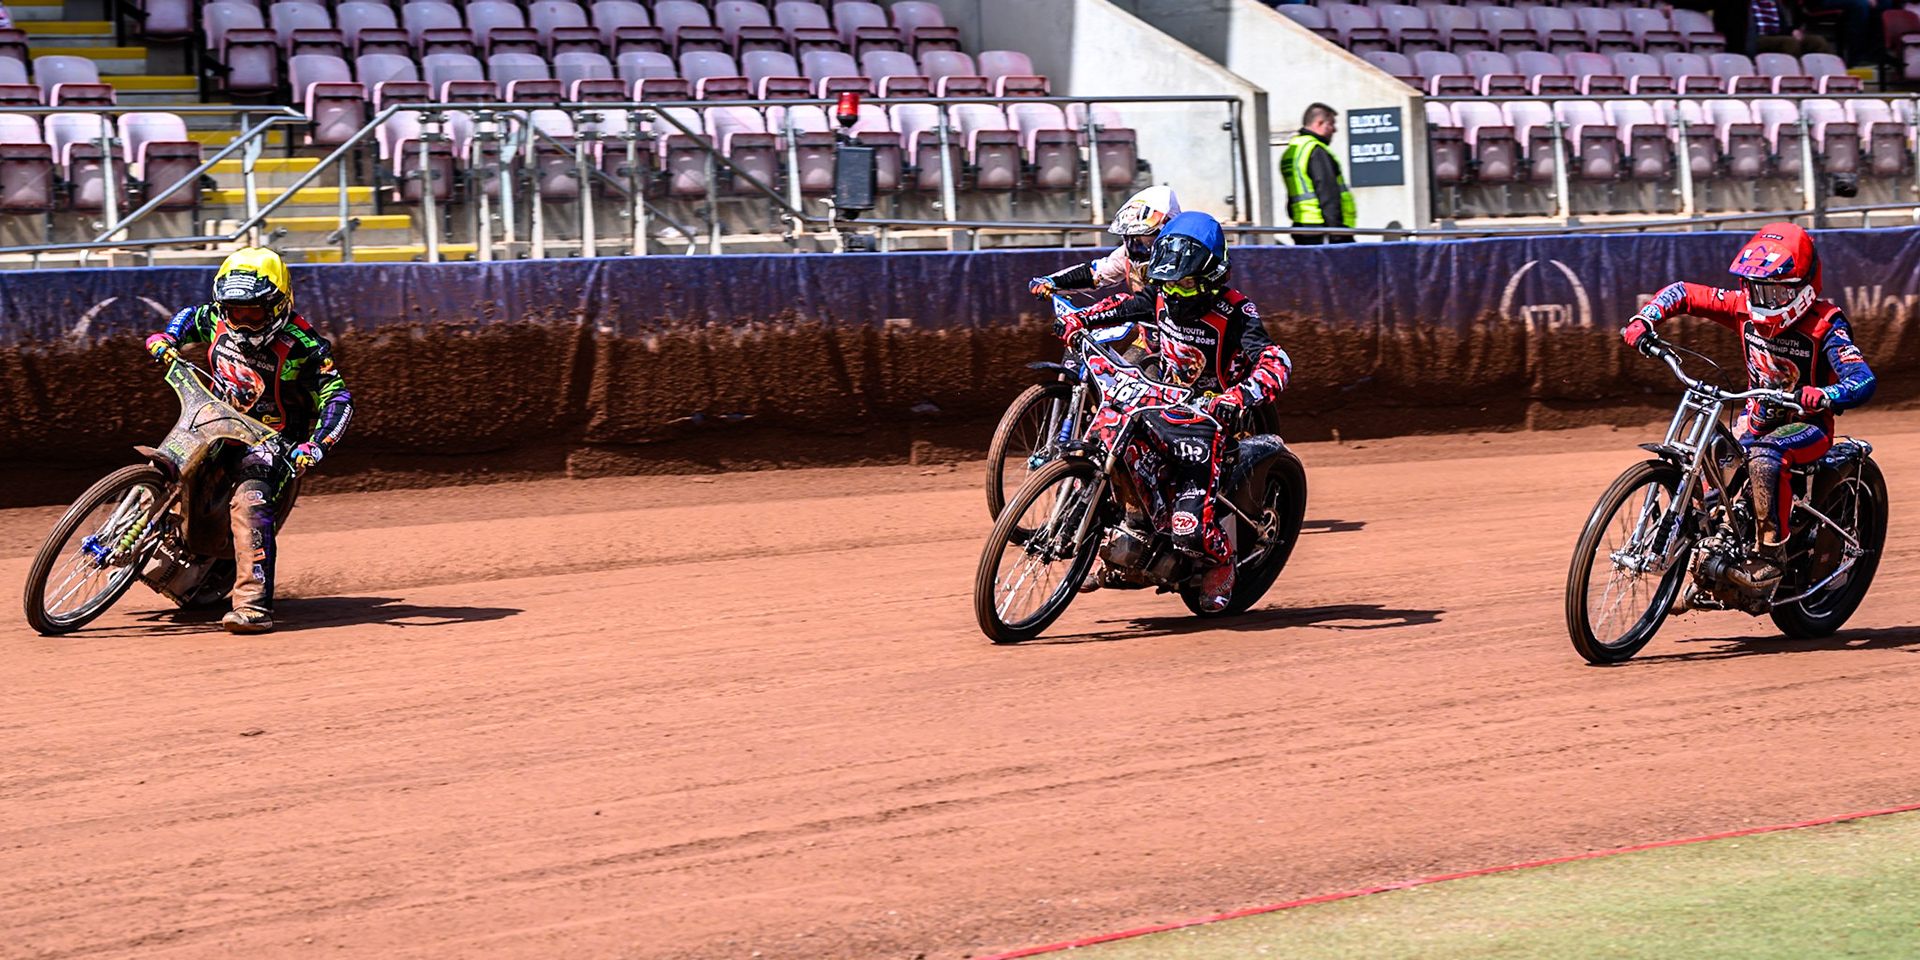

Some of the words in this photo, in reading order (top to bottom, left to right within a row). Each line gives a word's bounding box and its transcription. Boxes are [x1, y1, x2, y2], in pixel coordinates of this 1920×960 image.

[1350, 115, 1382, 127] BLOCK
[1383, 114, 1392, 126] C
[1351, 144, 1383, 156] BLOCK
[1183, 326, 1205, 336] YOUTH
[1195, 336, 1216, 345] 2025
[1776, 338, 1800, 347] YOUTH
[1789, 348, 1811, 357] 2025
[257, 360, 275, 372] 2025
[1106, 371, 1150, 407] 367
